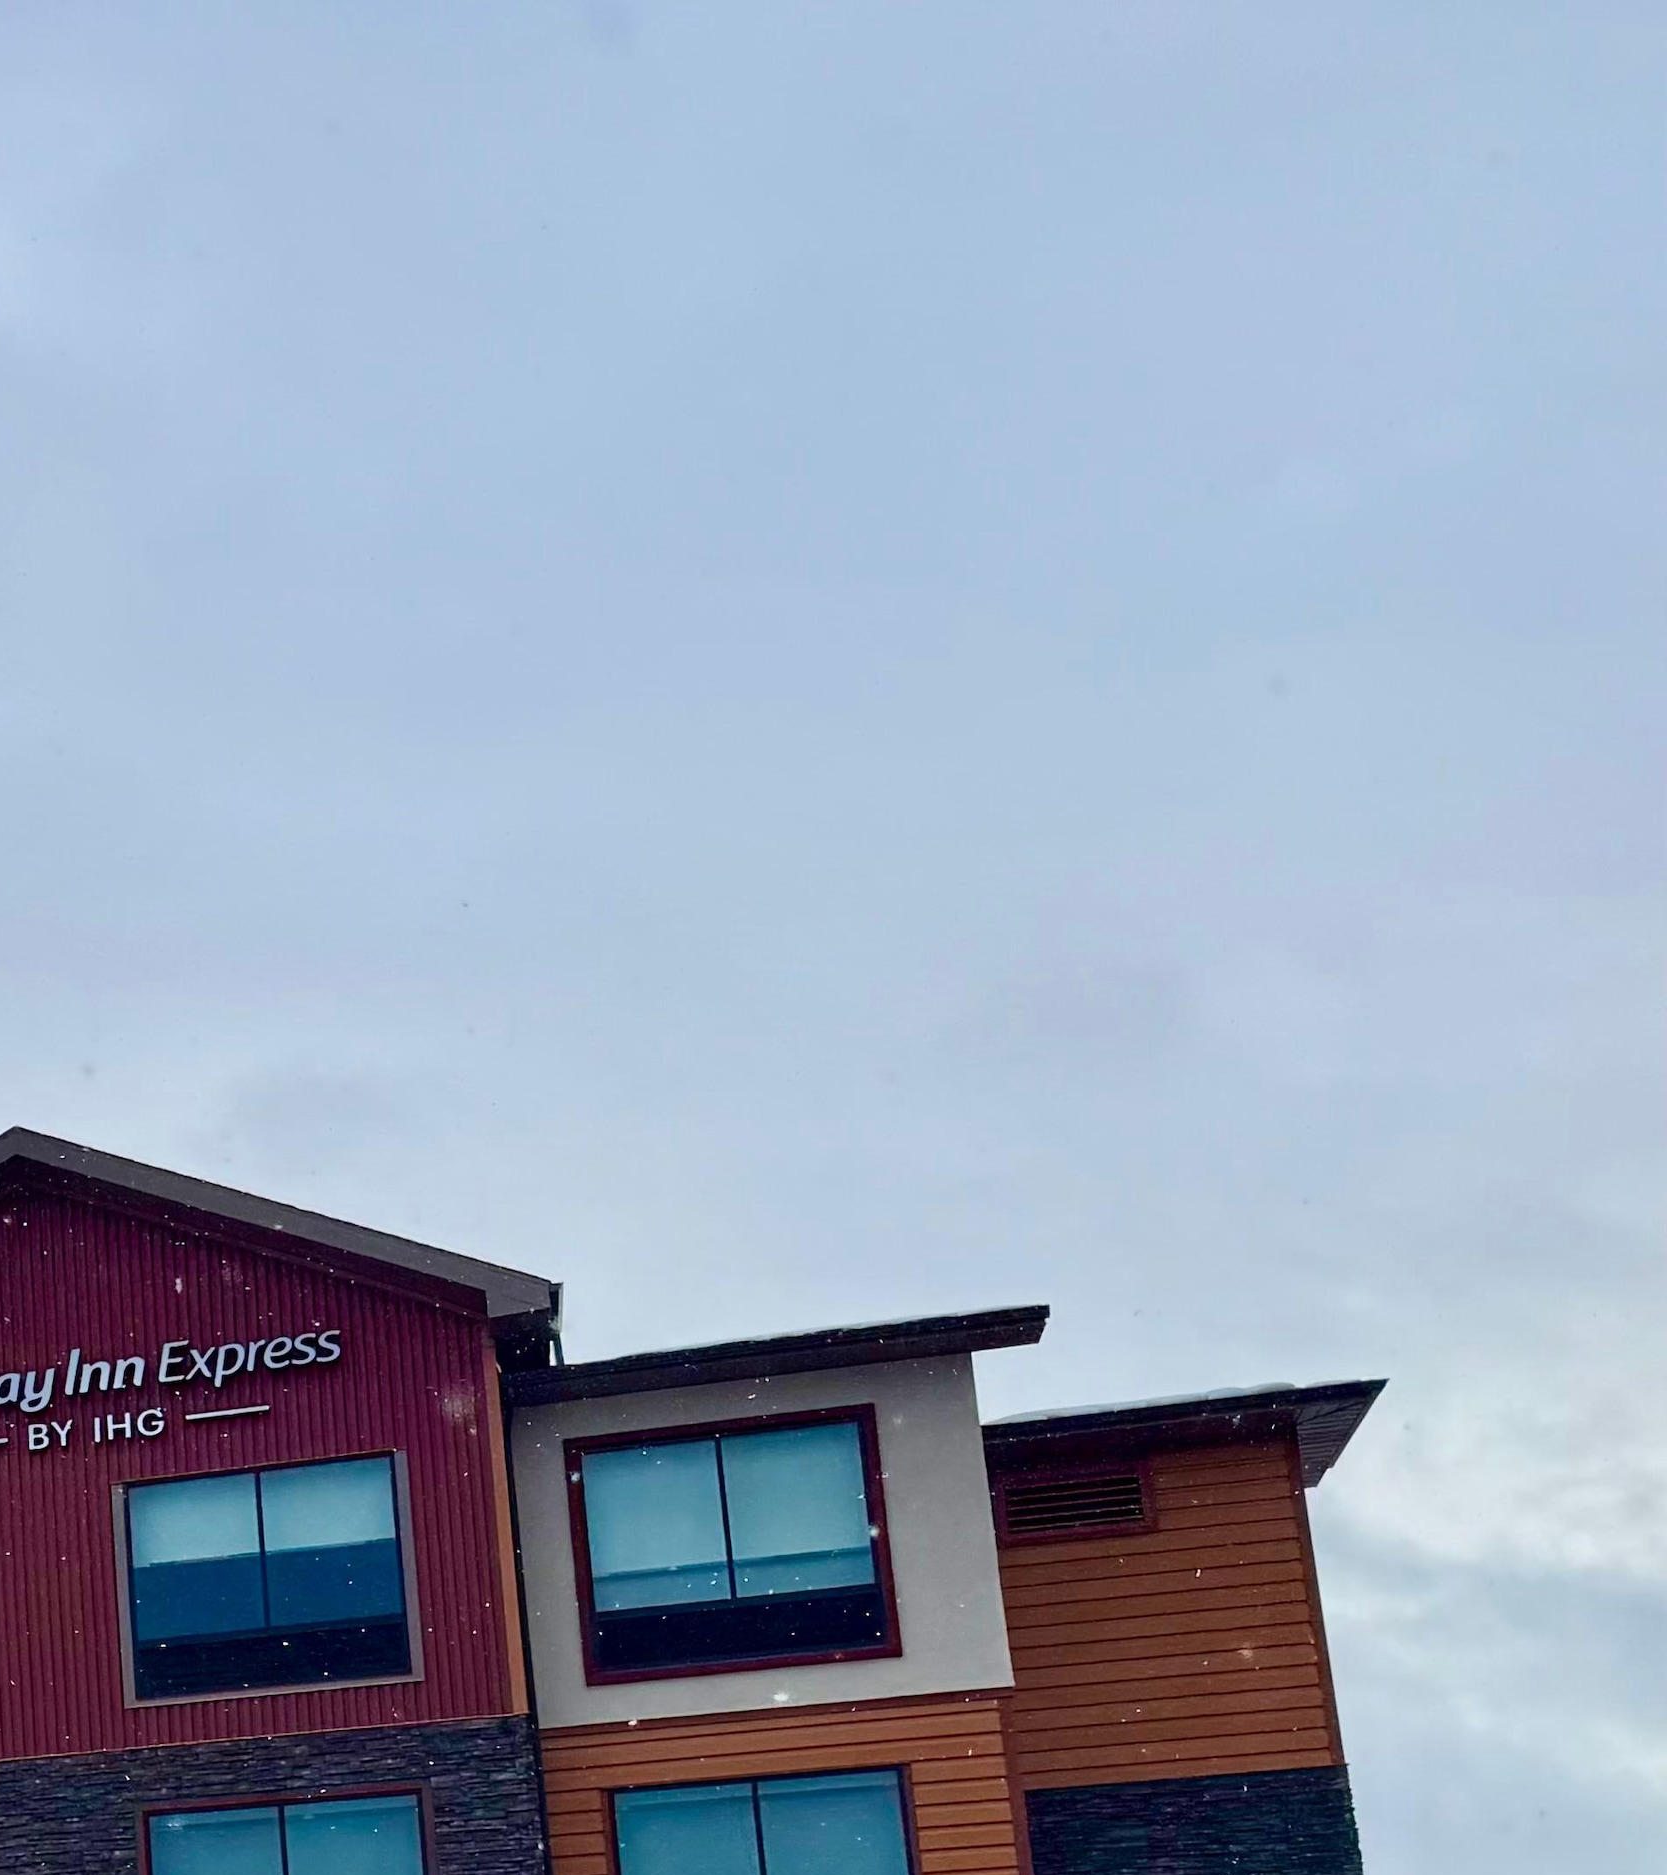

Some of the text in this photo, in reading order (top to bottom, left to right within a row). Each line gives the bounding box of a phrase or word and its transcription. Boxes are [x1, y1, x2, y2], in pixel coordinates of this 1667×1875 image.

[64, 1348, 145, 1396] Inn
[157, 1330, 341, 1388] Express
[28, 1408, 165, 1451] BY IHG
